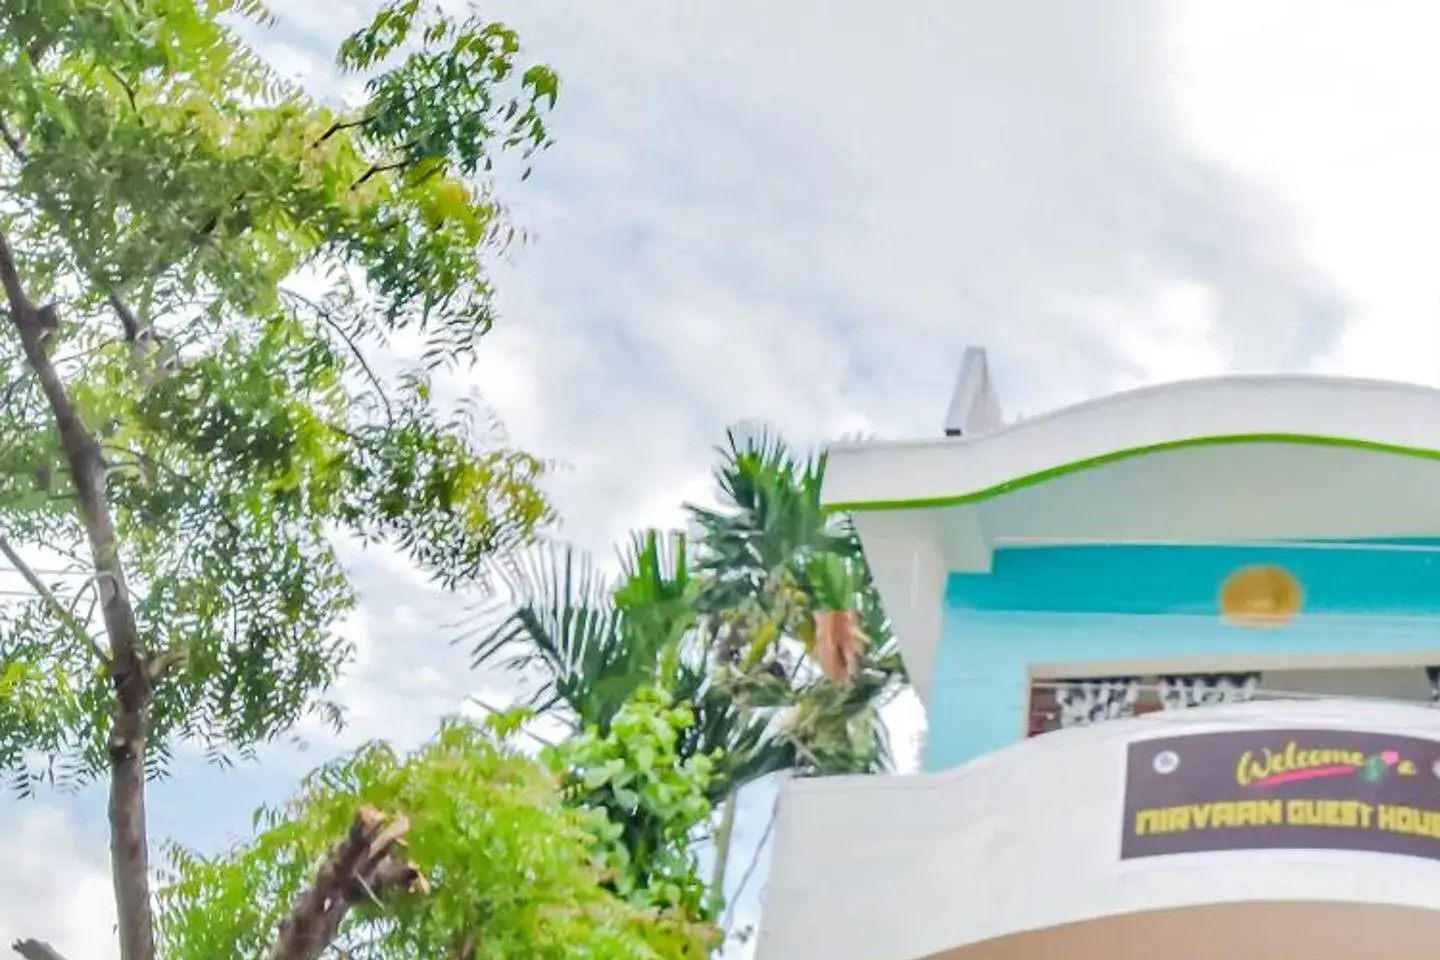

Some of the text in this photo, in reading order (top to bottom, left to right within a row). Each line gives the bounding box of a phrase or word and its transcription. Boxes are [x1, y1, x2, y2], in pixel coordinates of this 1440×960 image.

[1236, 740, 1364, 786] Welcome
[1135, 799, 1282, 836] NIRVAAN
[1286, 800, 1374, 828] GUEST
